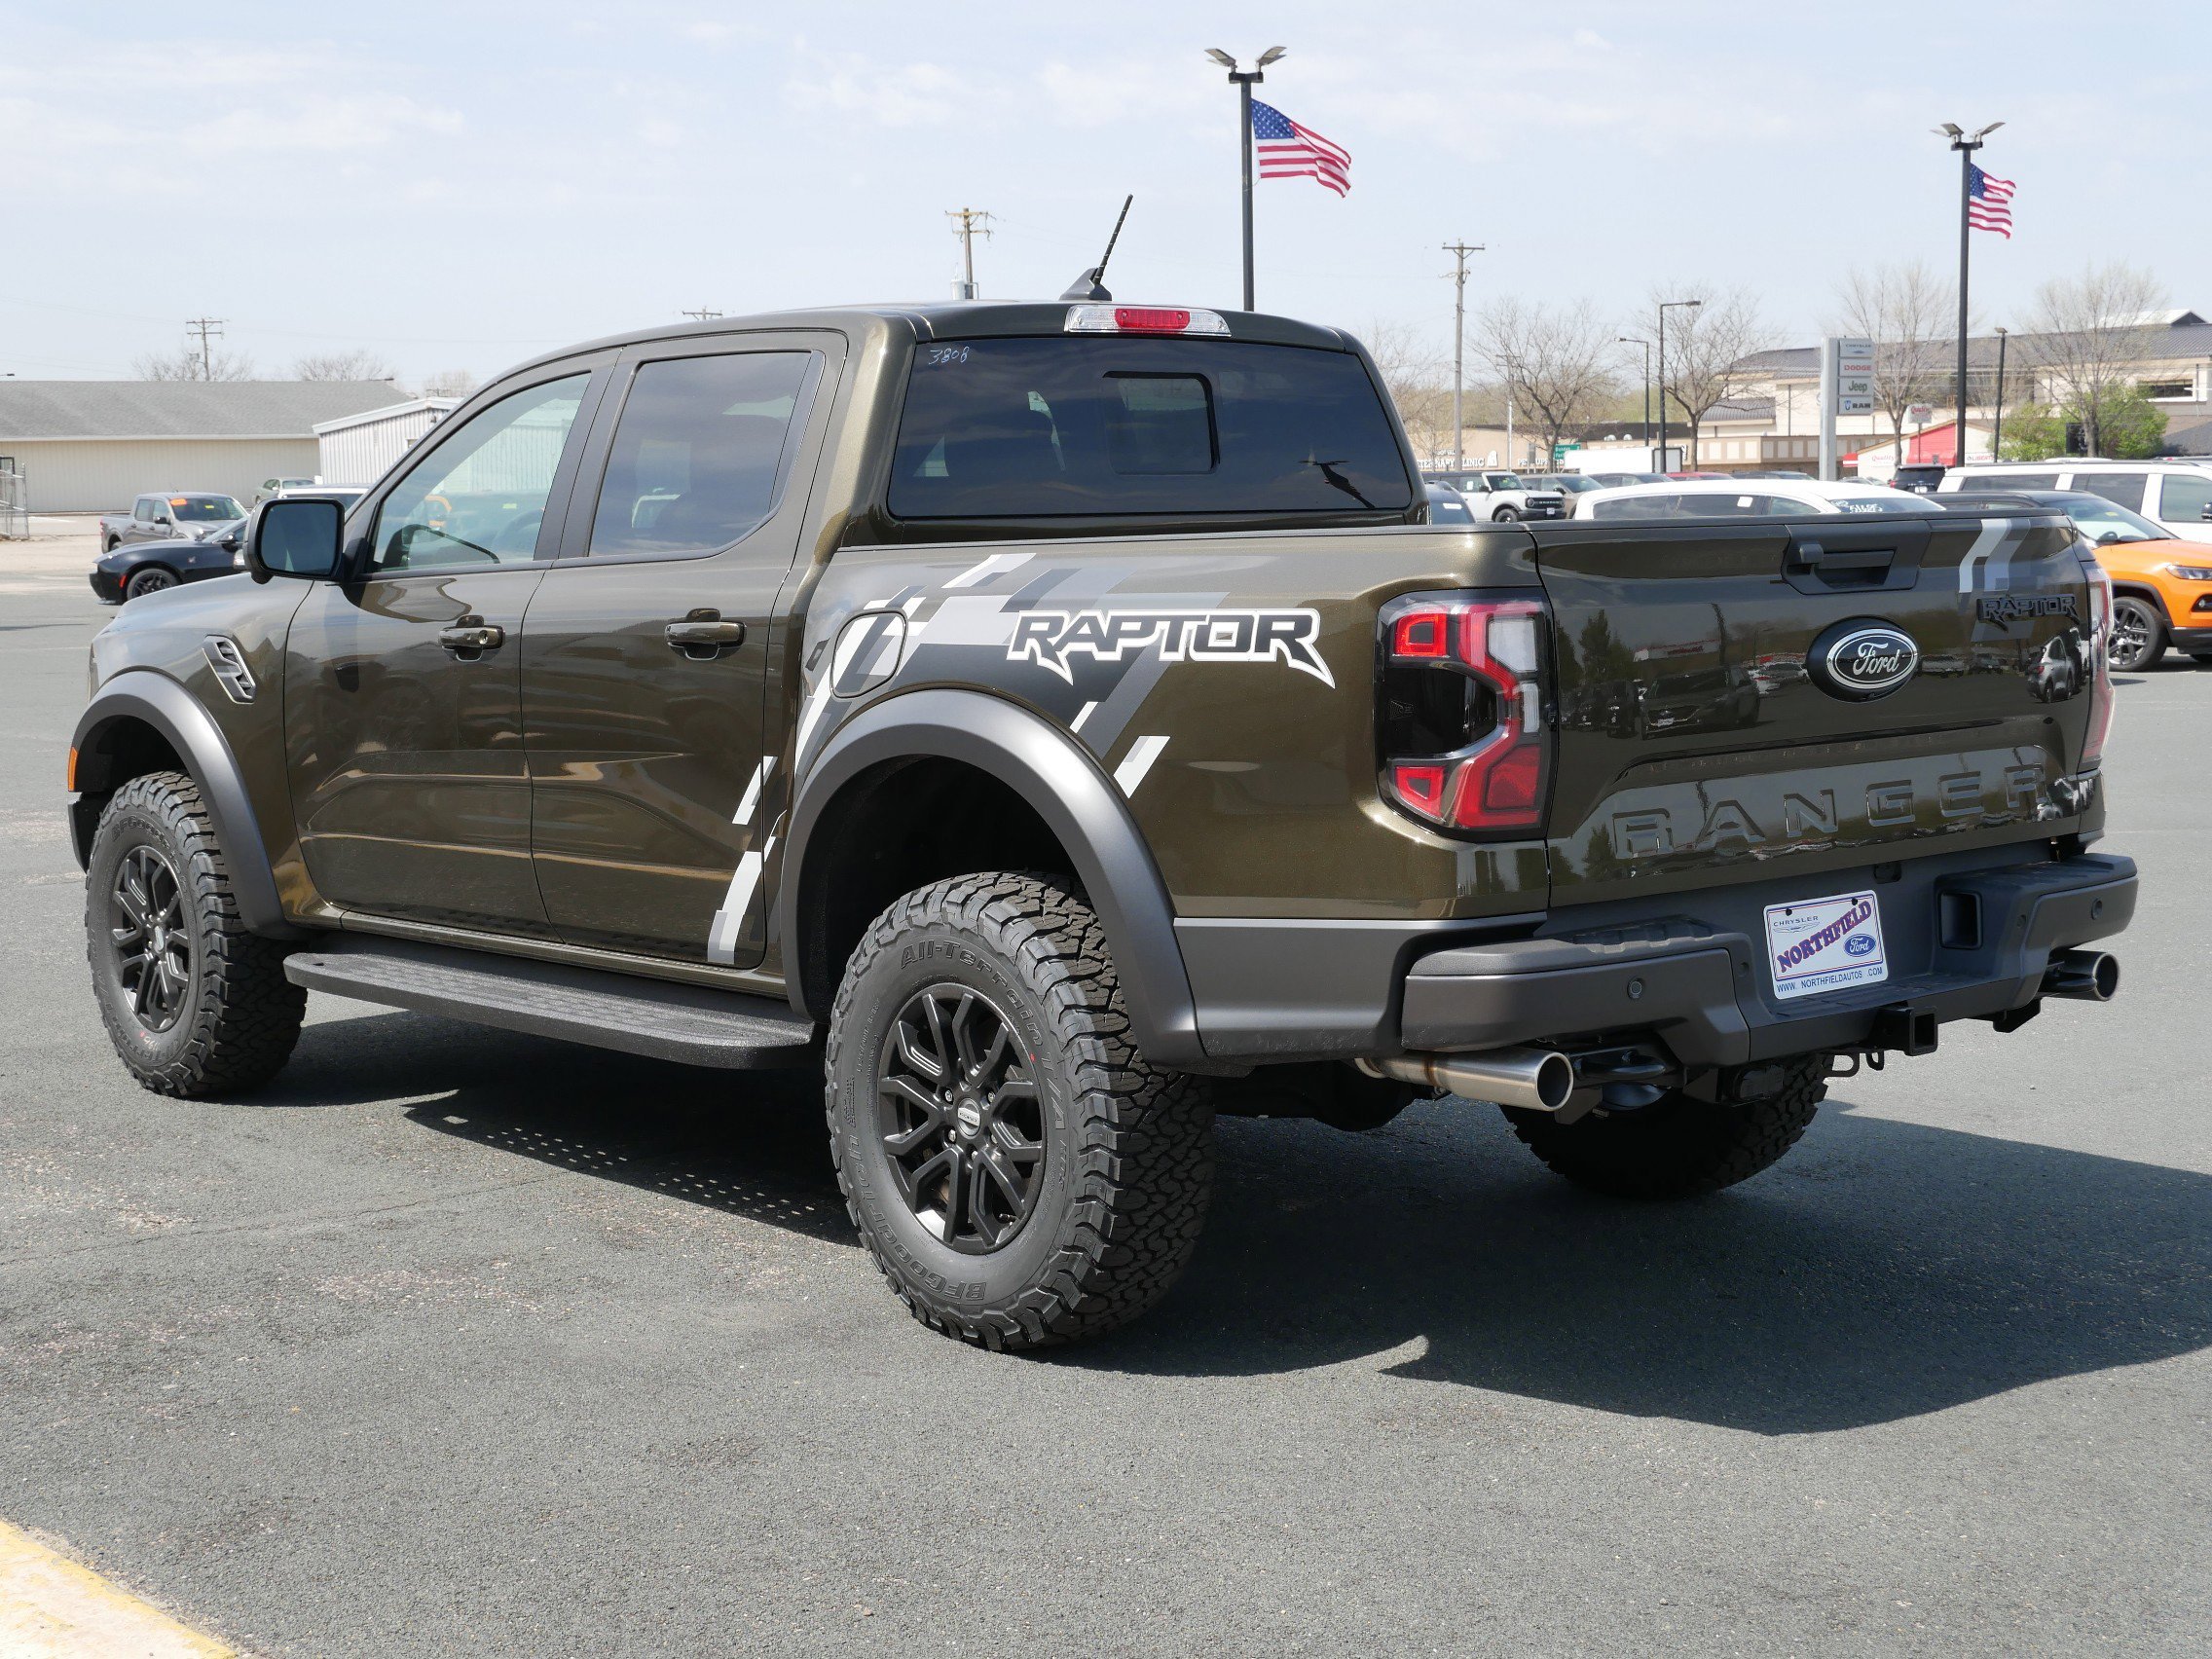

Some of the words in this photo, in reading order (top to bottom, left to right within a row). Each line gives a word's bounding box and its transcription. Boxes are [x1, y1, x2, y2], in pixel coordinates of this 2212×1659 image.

[928, 346, 970, 365] 3808
[1848, 381, 1867, 393] Jeep
[1461, 458, 1485, 467] LINIC
[1976, 593, 2081, 633] RAPTOR
[1006, 608, 1336, 689] RAPTOR
[1852, 642, 1899, 675] Ford
[1611, 763, 2047, 860] RANGER
[1773, 915, 1819, 927] CHRYSLER
[1777, 901, 1871, 973] NORTHFIELD
[1849, 937, 1870, 953] Ford
[1801, 971, 1862, 989] NORTHFIELDAUTOS
[848, 1134, 987, 1301] BFGoodrich
